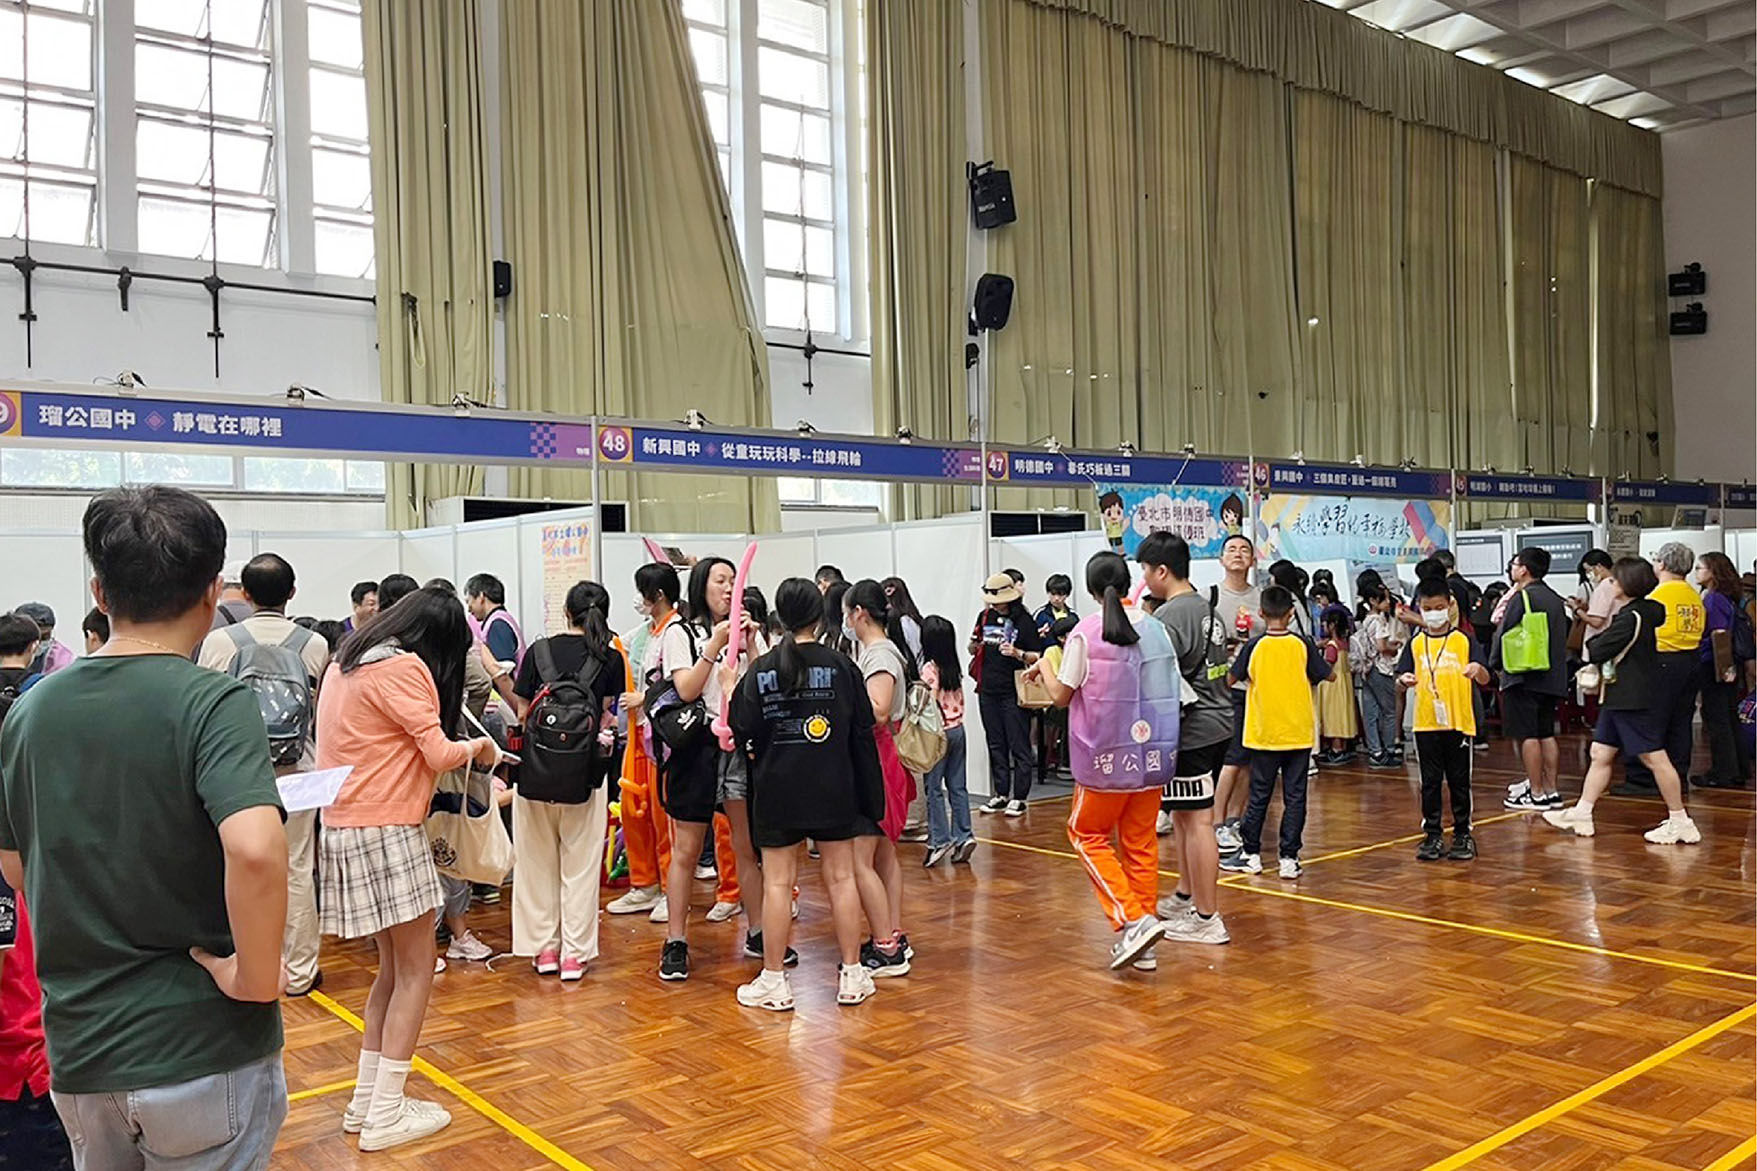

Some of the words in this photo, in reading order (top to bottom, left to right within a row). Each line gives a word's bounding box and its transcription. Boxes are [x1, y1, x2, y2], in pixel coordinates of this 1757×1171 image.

[39, 405, 136, 430] 瑠公國中
[172, 412, 283, 437] 靜電在哪裡
[603, 432, 626, 452] 48
[643, 437, 701, 457] 新興國中
[989, 456, 1003, 474] 47
[1015, 460, 1054, 475] 明德國中
[1255, 468, 1267, 483] 46
[1274, 470, 1304, 483] 景興國中
[1162, 780, 1203, 797] UMA
